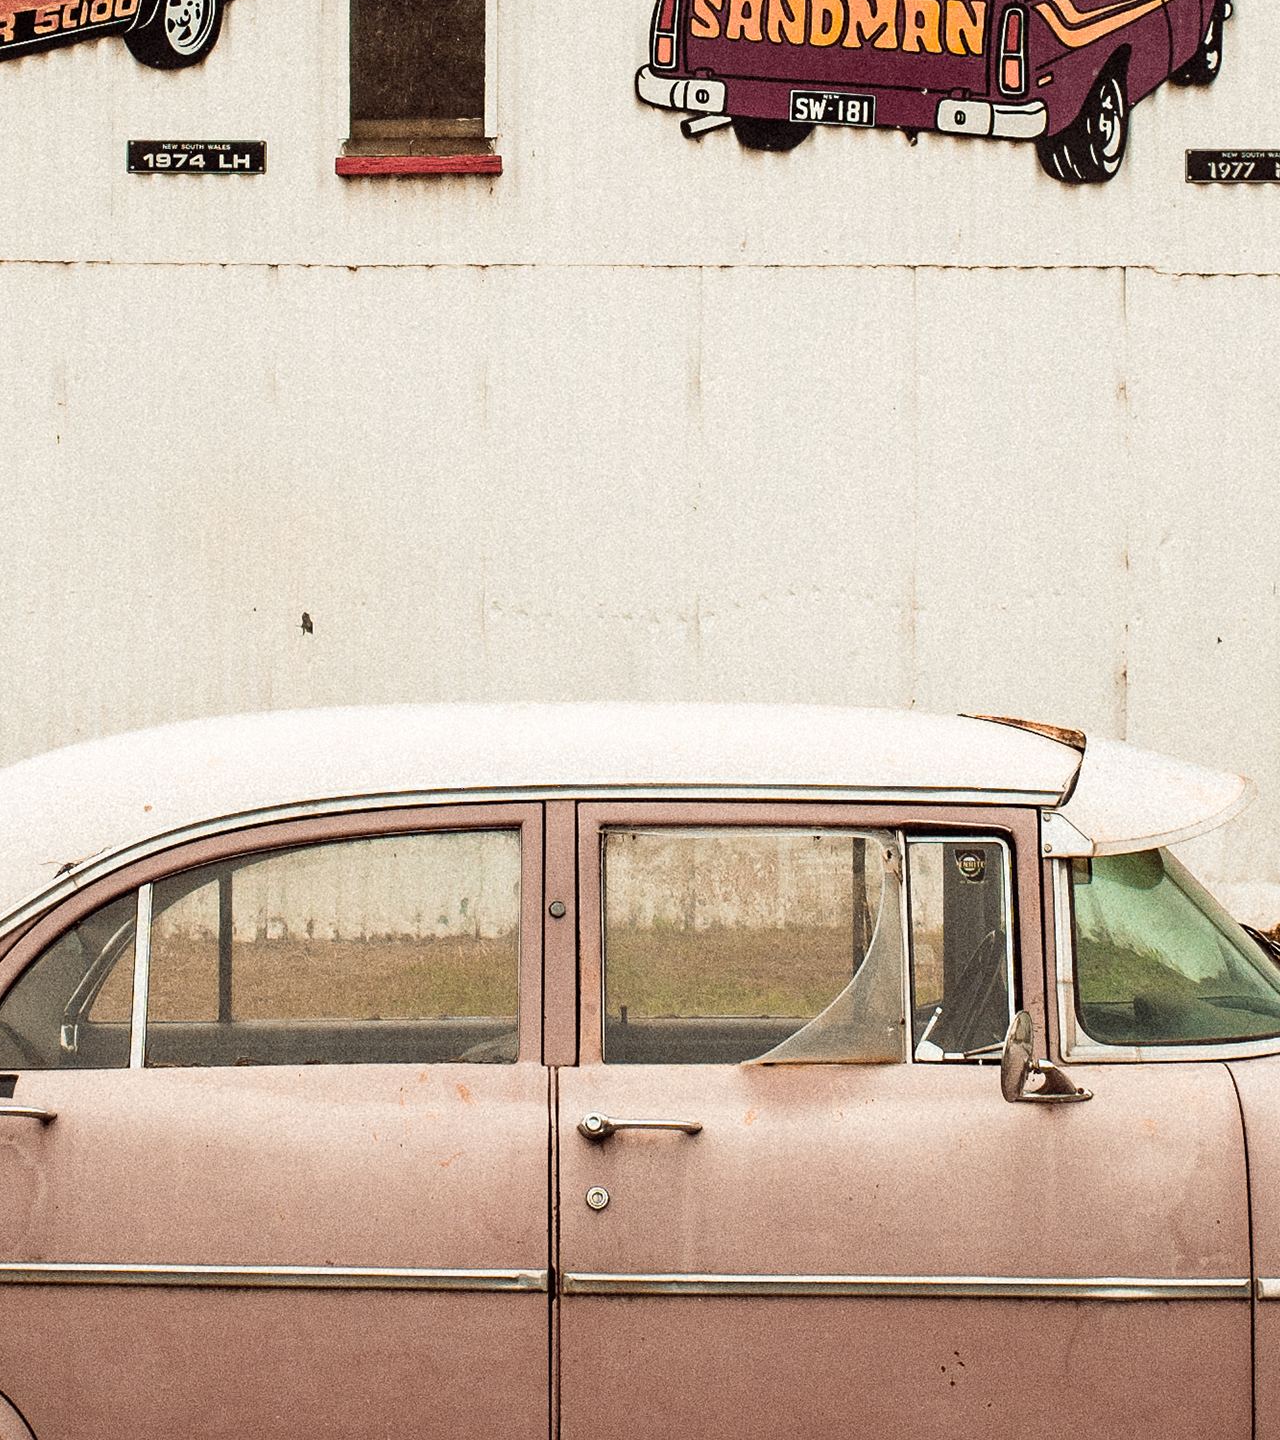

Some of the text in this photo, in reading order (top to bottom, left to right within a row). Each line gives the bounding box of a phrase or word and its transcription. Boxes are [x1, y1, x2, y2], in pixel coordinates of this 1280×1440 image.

[795, 97, 869, 123] SW-181
[208, 143, 231, 151] WALES
[143, 153, 251, 169] 1974 LH
[1207, 161, 1256, 179] 1977
